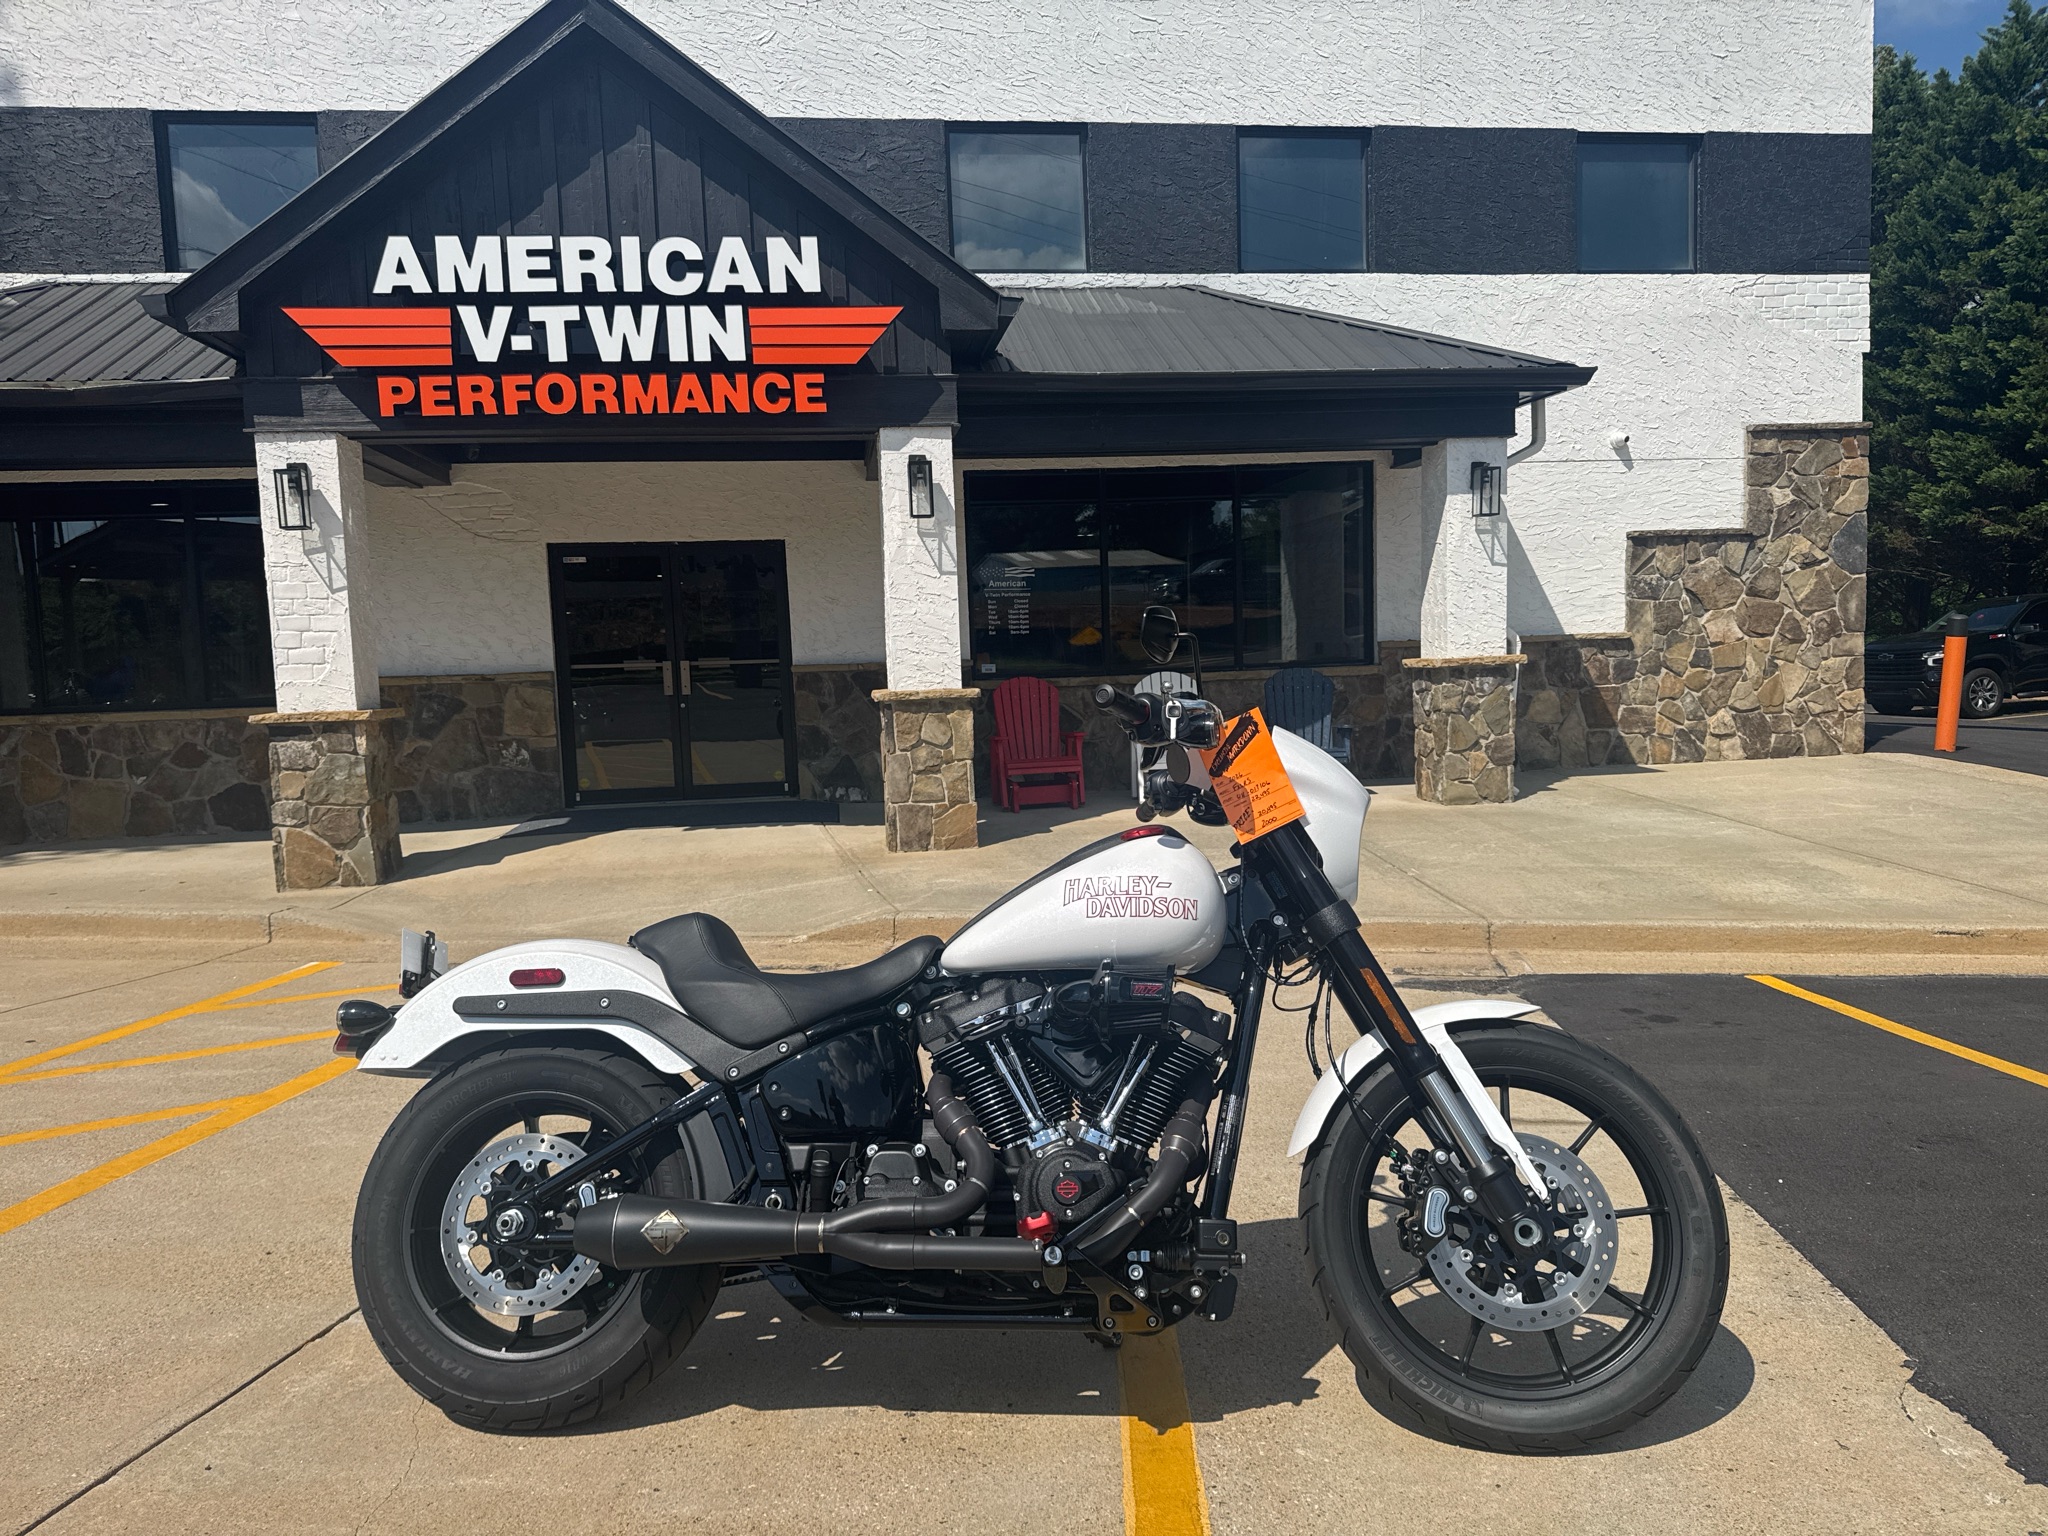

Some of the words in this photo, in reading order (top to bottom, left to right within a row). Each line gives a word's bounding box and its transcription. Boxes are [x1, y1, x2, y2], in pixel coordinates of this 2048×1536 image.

[372, 235, 821, 295] AMERICAN
[457, 304, 747, 363] V-TWIN
[376, 373, 828, 417] PERFORMANCE
[989, 580, 1027, 588] American
[1227, 723, 1256, 762] MARKDOWN
[1086, 897, 1198, 921] DAVIDSON
[430, 1077, 495, 1120] SCORCHER
[1370, 1335, 1460, 1406] MICHELIN
